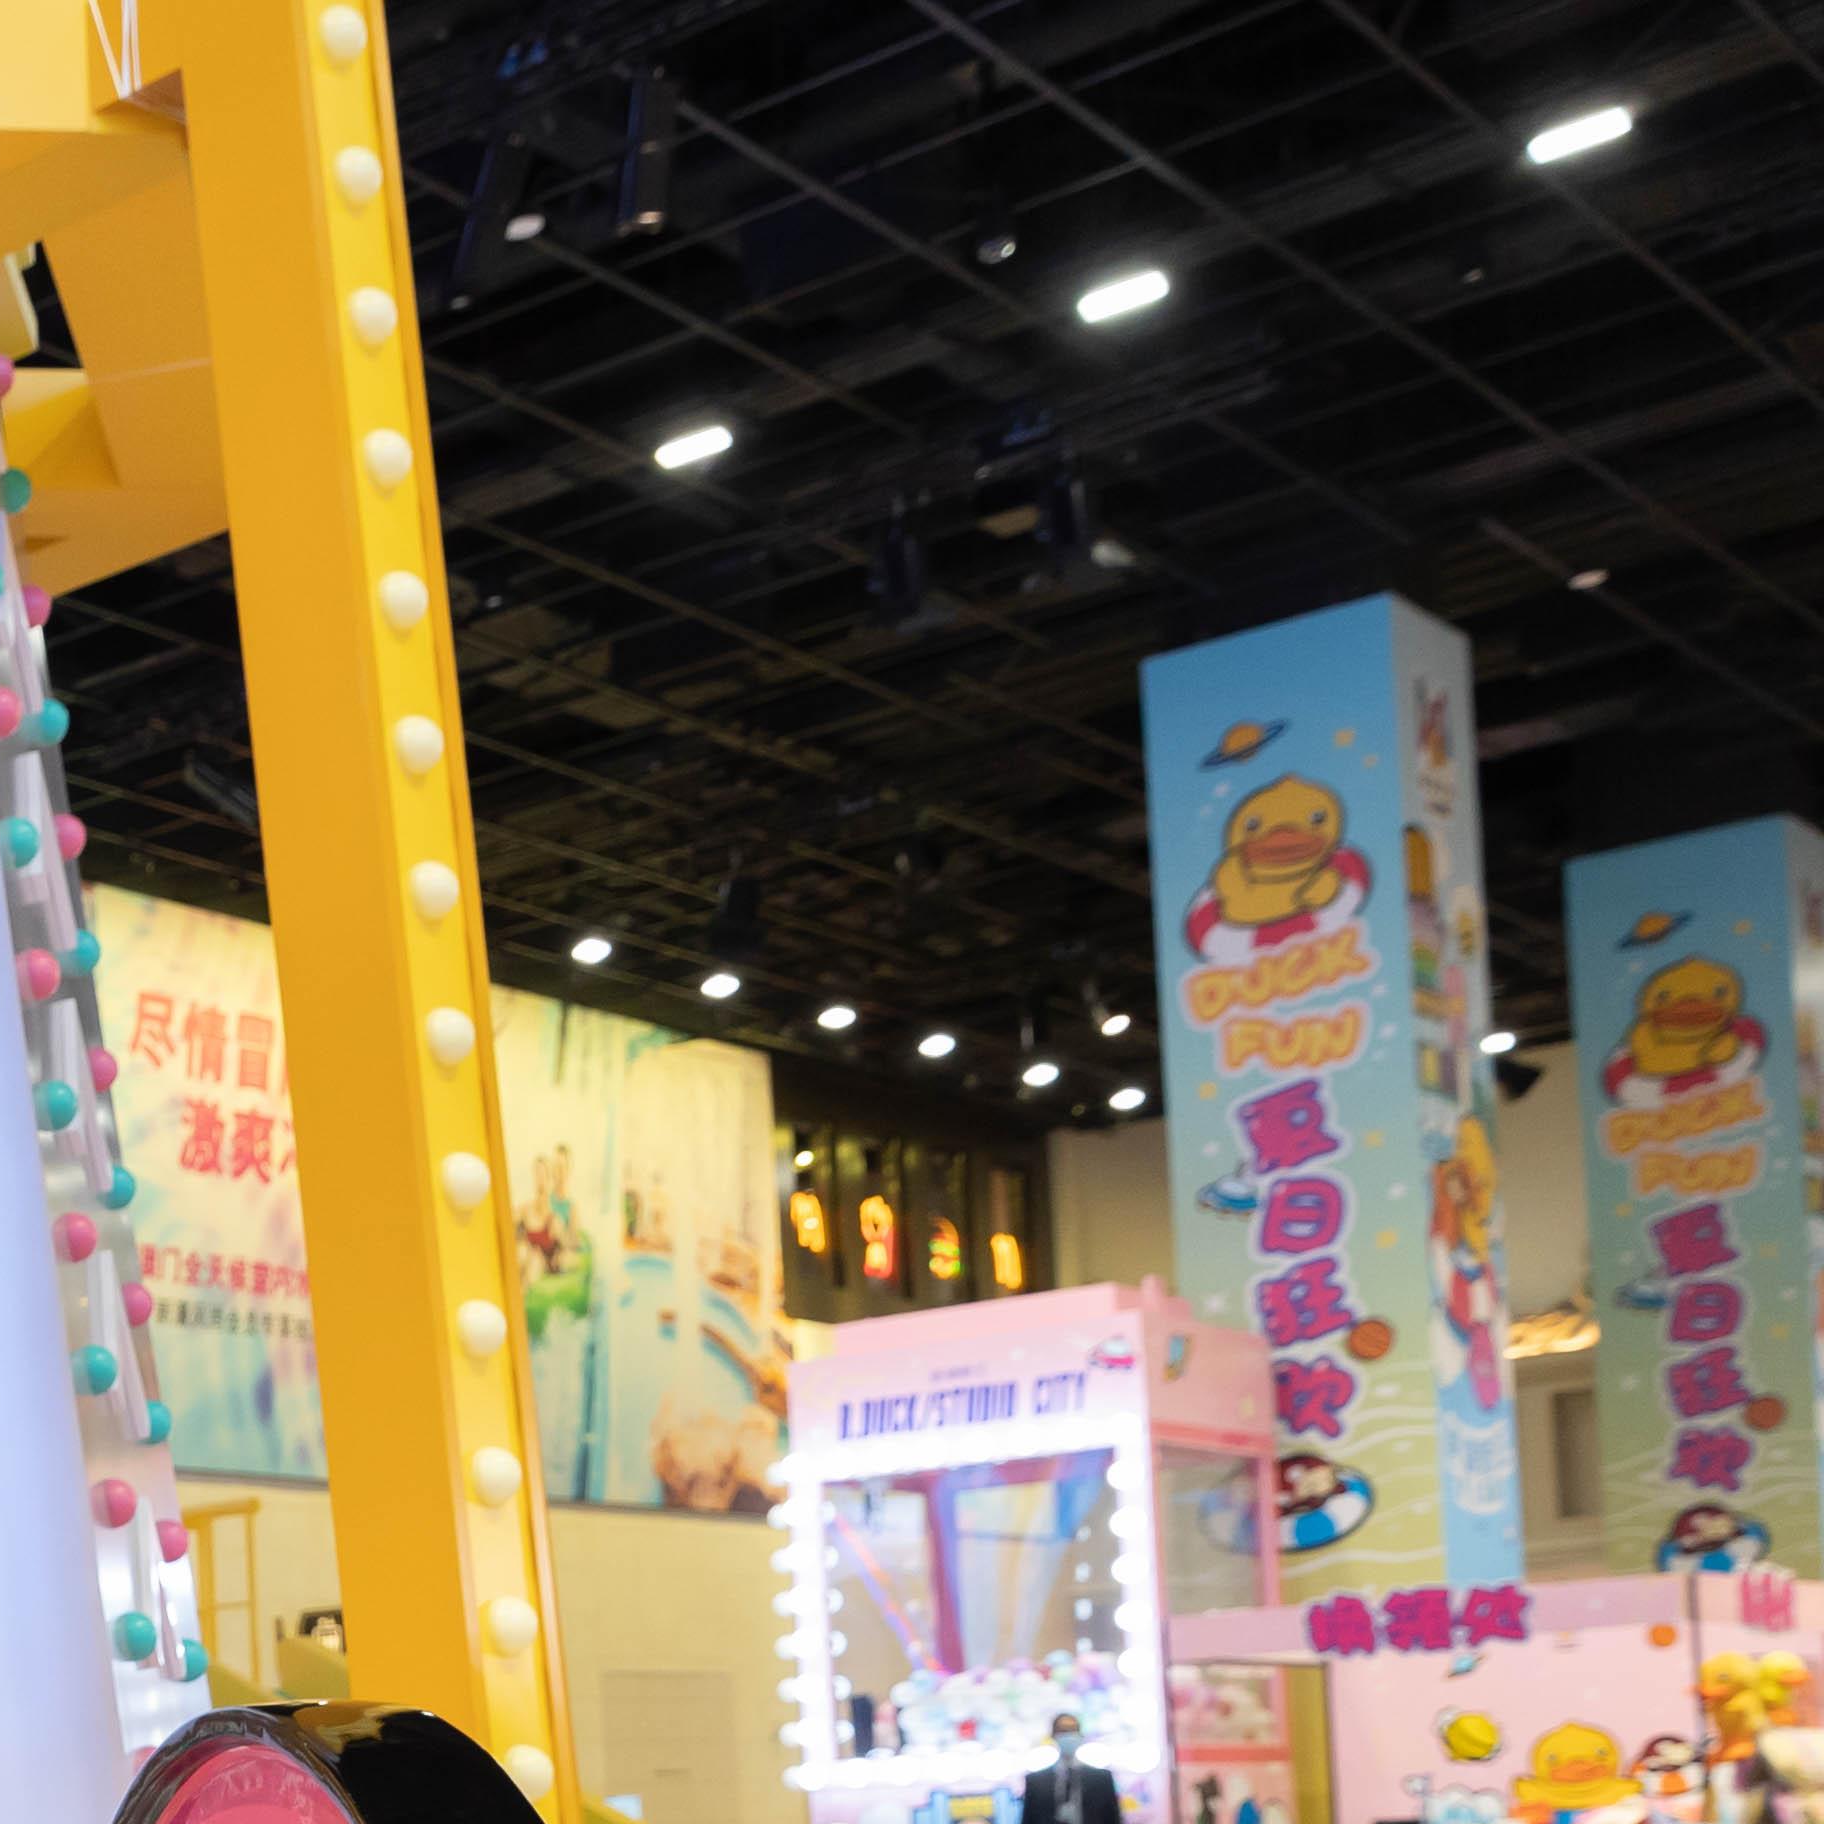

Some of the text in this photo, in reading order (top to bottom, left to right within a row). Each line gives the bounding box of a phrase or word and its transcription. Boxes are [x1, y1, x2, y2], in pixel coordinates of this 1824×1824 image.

[1186, 925, 1371, 1024] DUCK
[130, 992, 289, 1095] 尽情冒
[1222, 1008, 1360, 1071] FUN
[1608, 1082, 1765, 1153] DUCK
[1637, 1146, 1758, 1196] FUN
